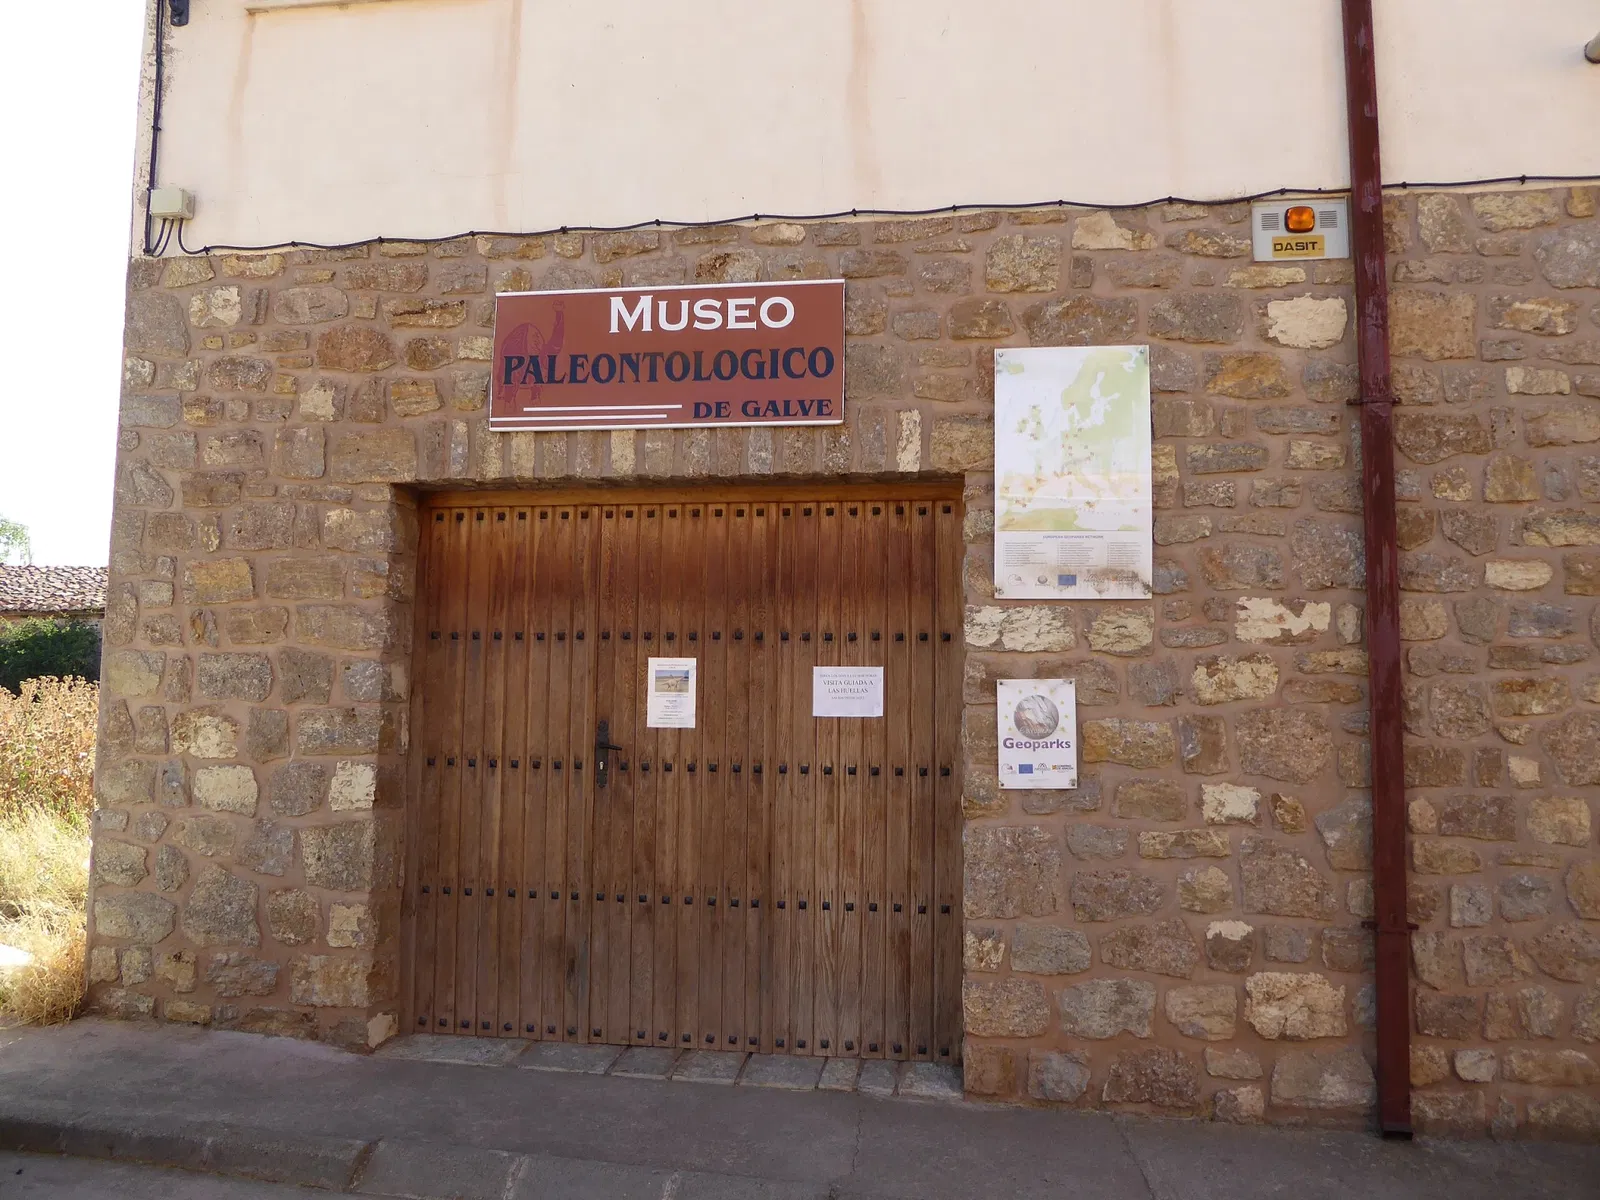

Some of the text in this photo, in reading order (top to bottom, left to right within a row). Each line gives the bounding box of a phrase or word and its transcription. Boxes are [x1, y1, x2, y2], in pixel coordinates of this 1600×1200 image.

[1273, 241, 1318, 252] DASIT
[609, 295, 795, 334] MUSEO
[503, 346, 835, 385] PALEONTOLOGICO
[693, 399, 834, 419] DE GALVE
[1002, 737, 1072, 752] Geoparks
